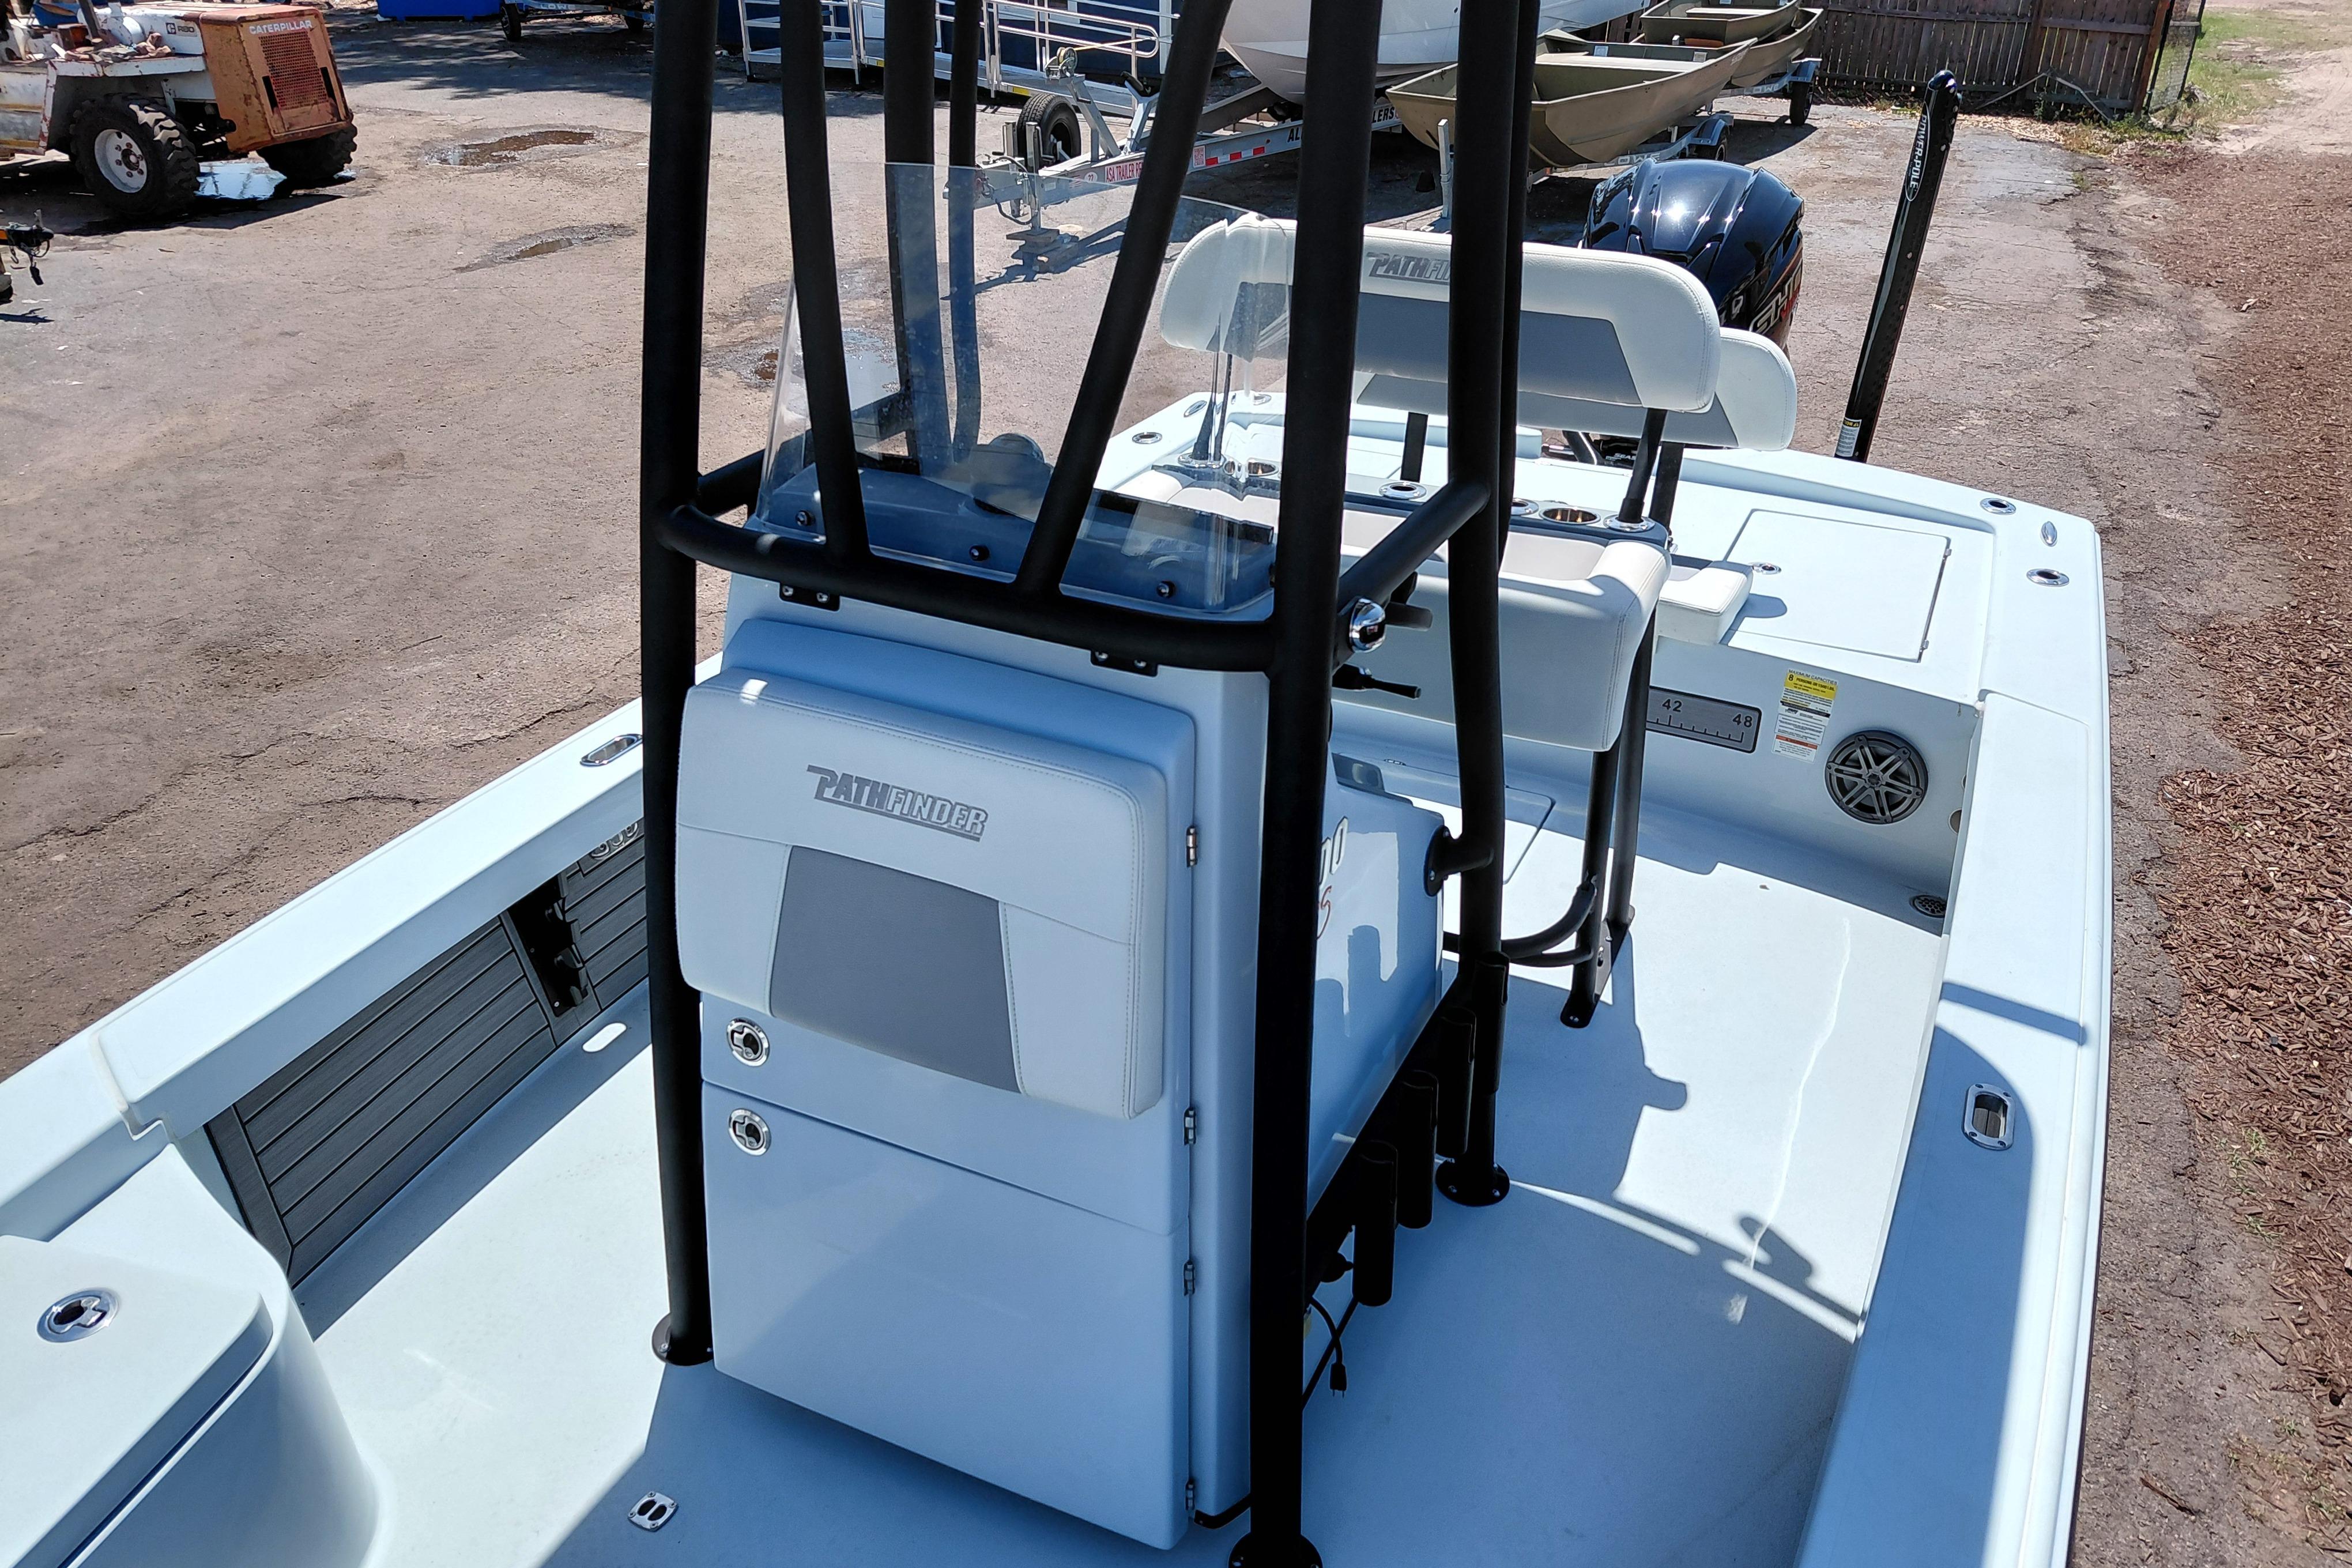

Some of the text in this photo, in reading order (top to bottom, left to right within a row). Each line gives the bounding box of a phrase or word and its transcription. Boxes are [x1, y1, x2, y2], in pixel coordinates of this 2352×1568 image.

[249, 20, 312, 34] CATERPILLAR
[1371, 106, 1395, 123] LERS
[1116, 163, 1135, 181] TRAILER
[1788, 669, 1811, 678] MAXIMUM
[1662, 699, 1683, 713] 42
[1732, 714, 1753, 728] 48
[806, 764, 989, 842] PATHFINDER
